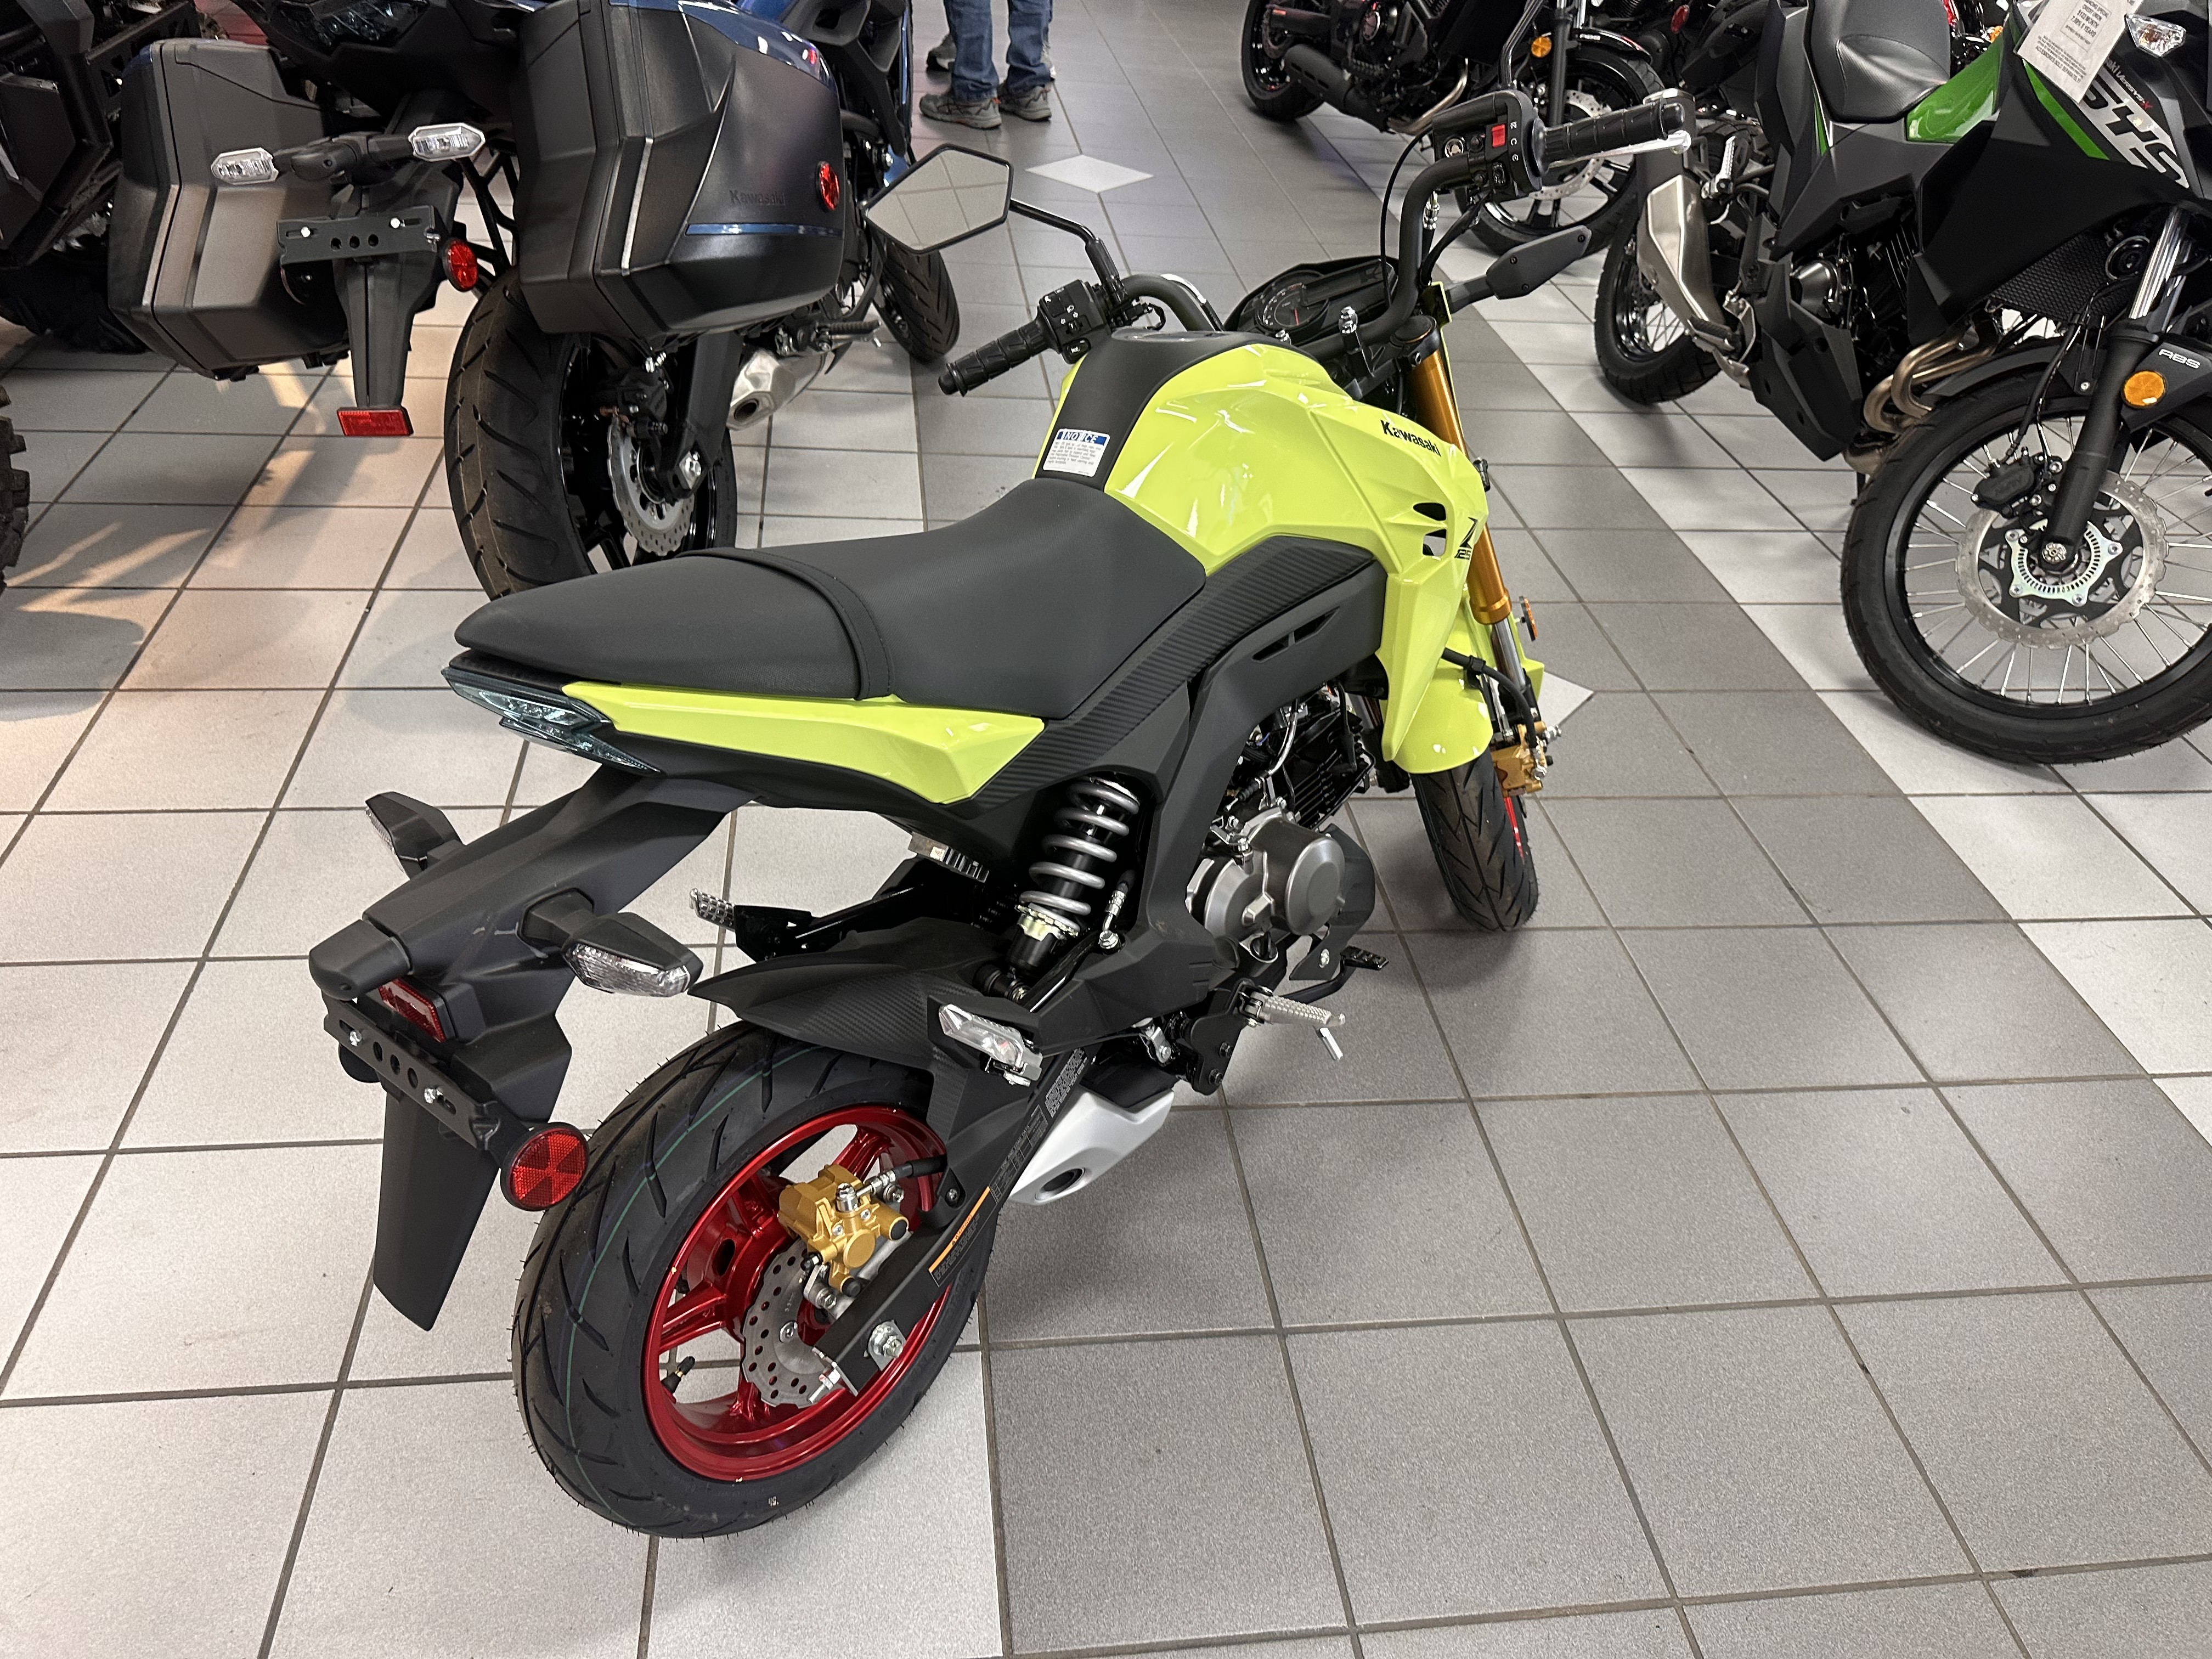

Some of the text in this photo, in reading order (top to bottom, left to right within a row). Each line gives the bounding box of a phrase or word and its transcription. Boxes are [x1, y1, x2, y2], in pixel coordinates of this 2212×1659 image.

[2083, 25, 2097, 38] YEARS
[729, 189, 786, 206] Kawasaki
[2158, 348, 2201, 369] ABS
[1380, 419, 1441, 457] Kawasaki
